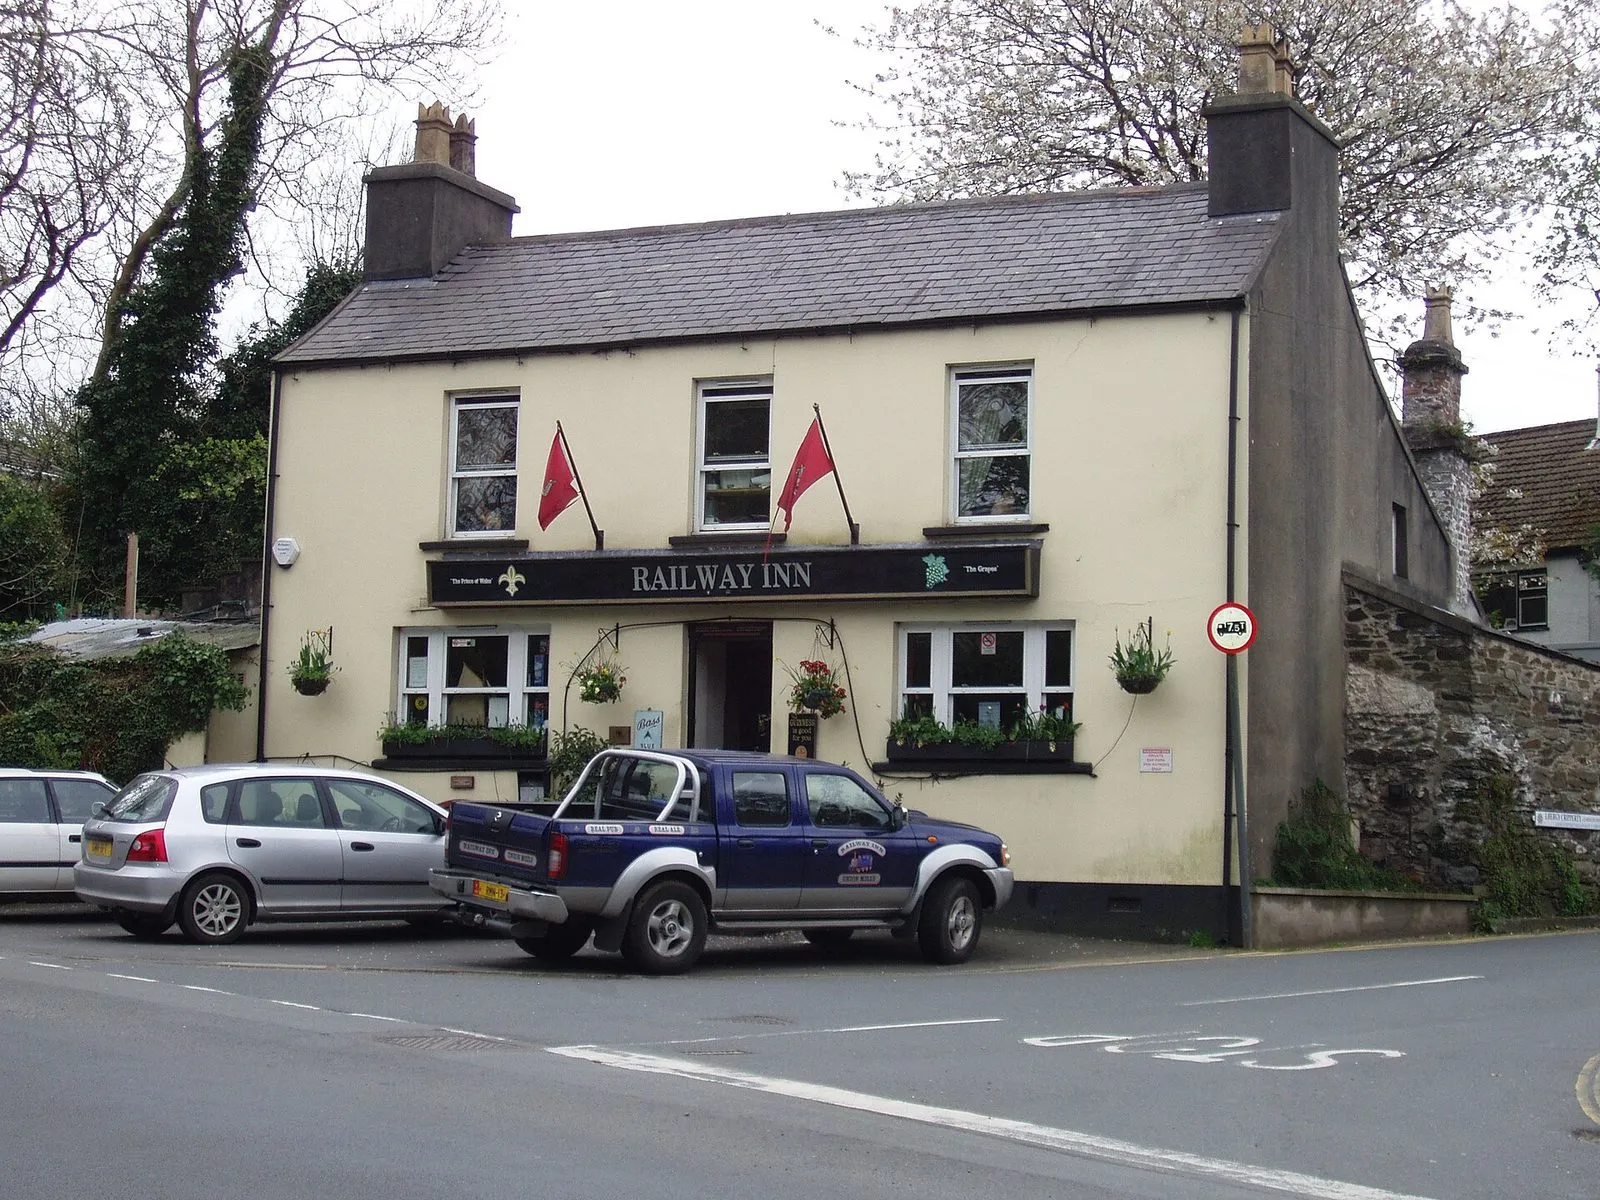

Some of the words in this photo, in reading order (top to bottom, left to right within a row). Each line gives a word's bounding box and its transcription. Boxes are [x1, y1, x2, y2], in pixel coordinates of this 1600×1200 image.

[632, 564, 755, 592] RAILWAY
[761, 562, 812, 588] INN
[637, 716, 660, 731] Bass
[790, 719, 815, 727] GUINNESS
[653, 826, 669, 834] REAL
[841, 841, 870, 853] RAILWAY
[1020, 1031, 1407, 1070] STOP
